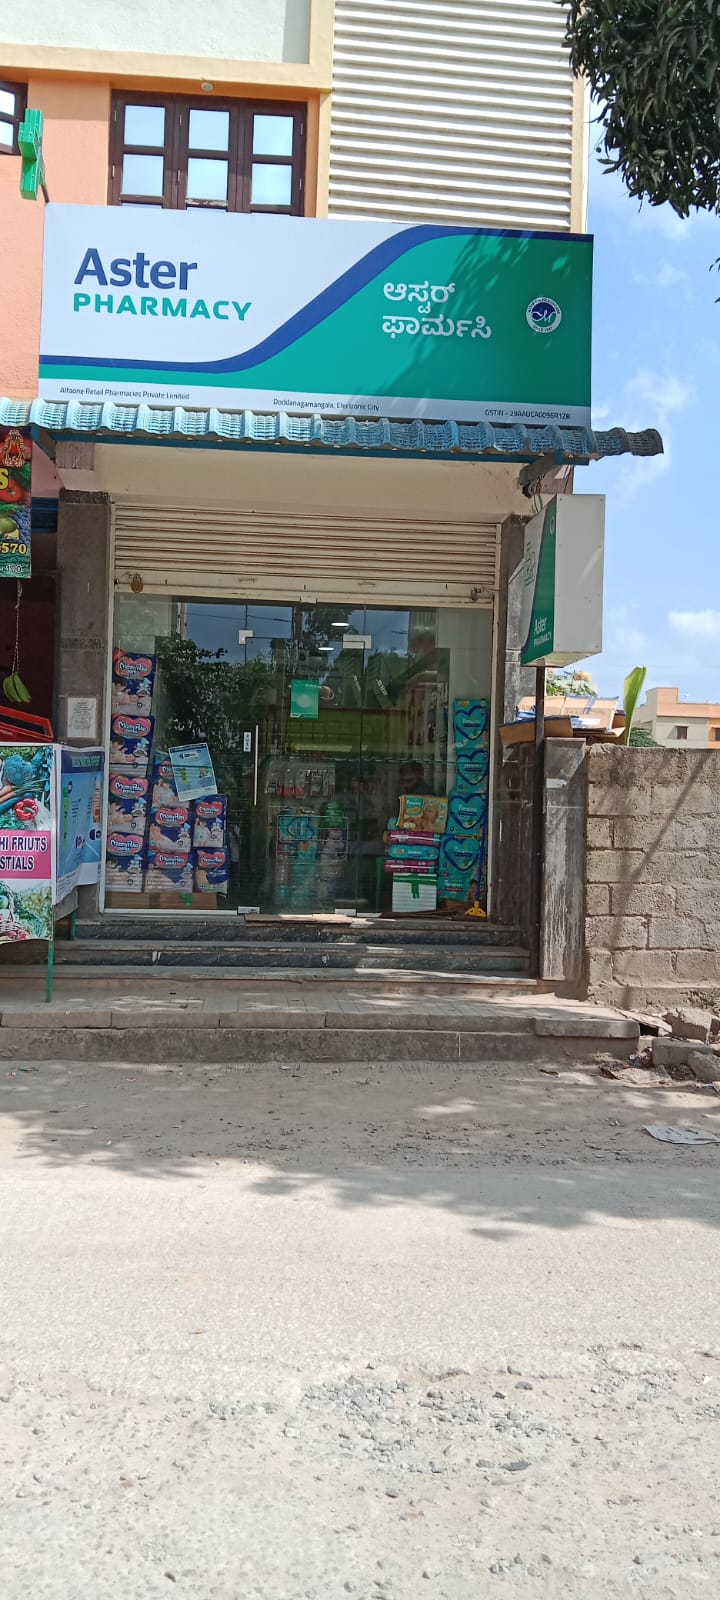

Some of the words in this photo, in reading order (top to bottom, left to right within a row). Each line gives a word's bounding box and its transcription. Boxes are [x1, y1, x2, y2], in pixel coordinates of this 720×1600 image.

[74, 248, 198, 291] Aster
[382, 281, 456, 314] ಆಸ್ಟರ್
[73, 293, 252, 321] PHARMACY
[382, 314, 493, 339] ಫಾರ್ಮಸಿ
[85, 388, 104, 396] Retail
[104, 389, 142, 398] Pharmacies
[142, 391, 165, 399] Private
[166, 392, 190, 400] Limited
[336, 402, 366, 410] Electronic
[367, 404, 380, 412] City
[484, 409, 504, 417] GSTIN
[11, 837, 47, 851] FRIUTS
[0, 856, 34, 870] STIALS
